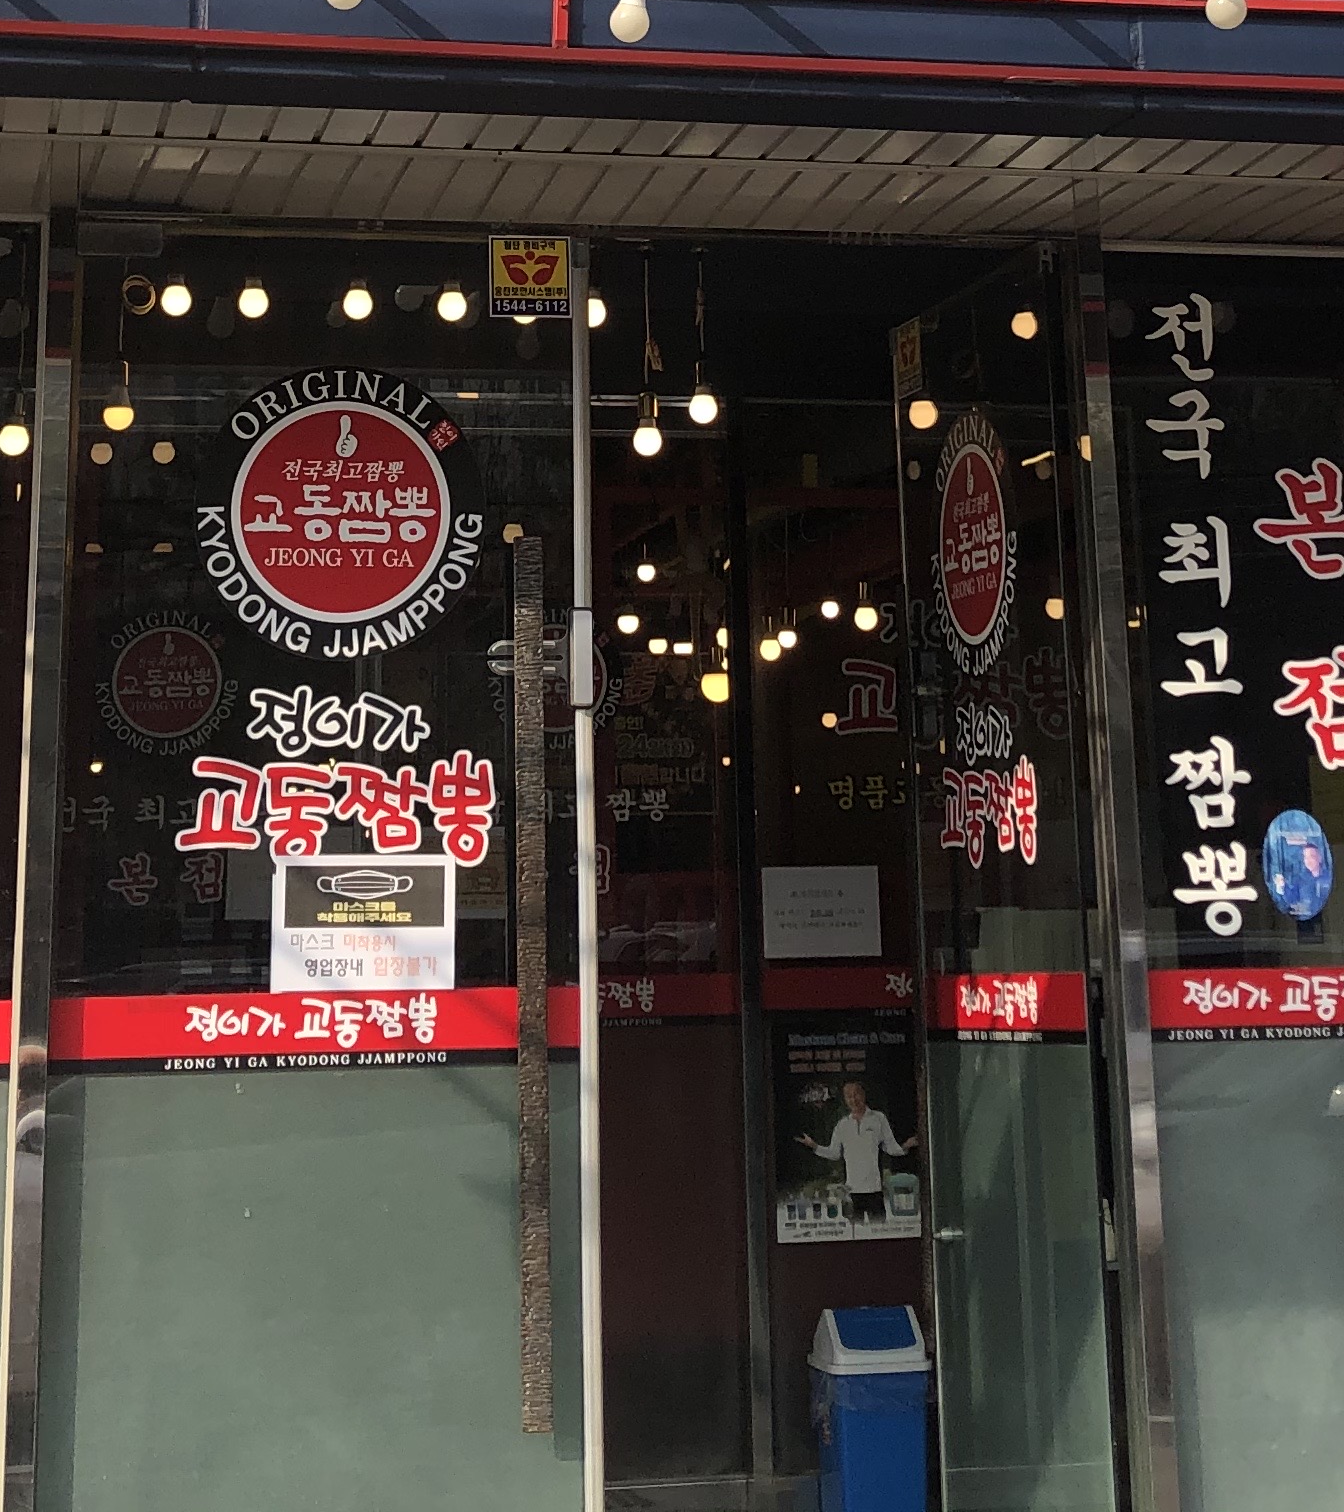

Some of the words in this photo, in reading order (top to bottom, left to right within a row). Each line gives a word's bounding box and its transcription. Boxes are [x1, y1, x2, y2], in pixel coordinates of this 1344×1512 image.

[494, 299, 568, 313] 1544-6112
[231, 370, 433, 440] ORIGINAL
[1145, 292, 1225, 481] 전국
[280, 459, 405, 483] 전국최고짬뽕
[936, 413, 996, 491] ORIGINAL
[243, 483, 437, 544] 교동짬뽕
[944, 512, 1002, 574] 교동짬뽕
[196, 504, 313, 654] KYODONG
[322, 512, 484, 659] JJAMPPONG
[264, 547, 342, 567] JEONG
[349, 548, 375, 567] YI
[382, 549, 415, 568] GA
[110, 609, 213, 650] ORIGINAL
[930, 553, 970, 675] KYODONG
[972, 530, 1018, 676] JJAMPPONG
[1158, 515, 1244, 700] 최고
[118, 667, 216, 699] 교동짬뽕
[94, 680, 154, 756] KYODONG
[159, 678, 241, 756] JJAMPPONG
[247, 685, 431, 758] 정이가
[174, 750, 496, 867] 교동짬뽕
[940, 754, 1039, 870] 교동짬뽕
[1165, 734, 1260, 938] 짬뽕
[290, 933, 335, 953] 마스크
[342, 933, 397, 953] 미착용시
[304, 957, 364, 978] 영업장내
[373, 956, 438, 978] 입장불가
[184, 1004, 287, 1043] 정이가
[293, 992, 439, 1049] 교동짬뽕
[1183, 977, 1273, 1015] 정이가
[164, 1058, 217, 1071] JEONG
[223, 1057, 241, 1069] YI
[247, 1057, 269, 1069] GA
[275, 1054, 351, 1067] KYODONG
[356, 1052, 448, 1065] JJAMPPONG
[1167, 1028, 1214, 1041] JEONG
[1219, 1028, 1235, 1040] YI
[1240, 1028, 1260, 1039] GA
[1265, 1027, 1332, 1039] KYODONG
